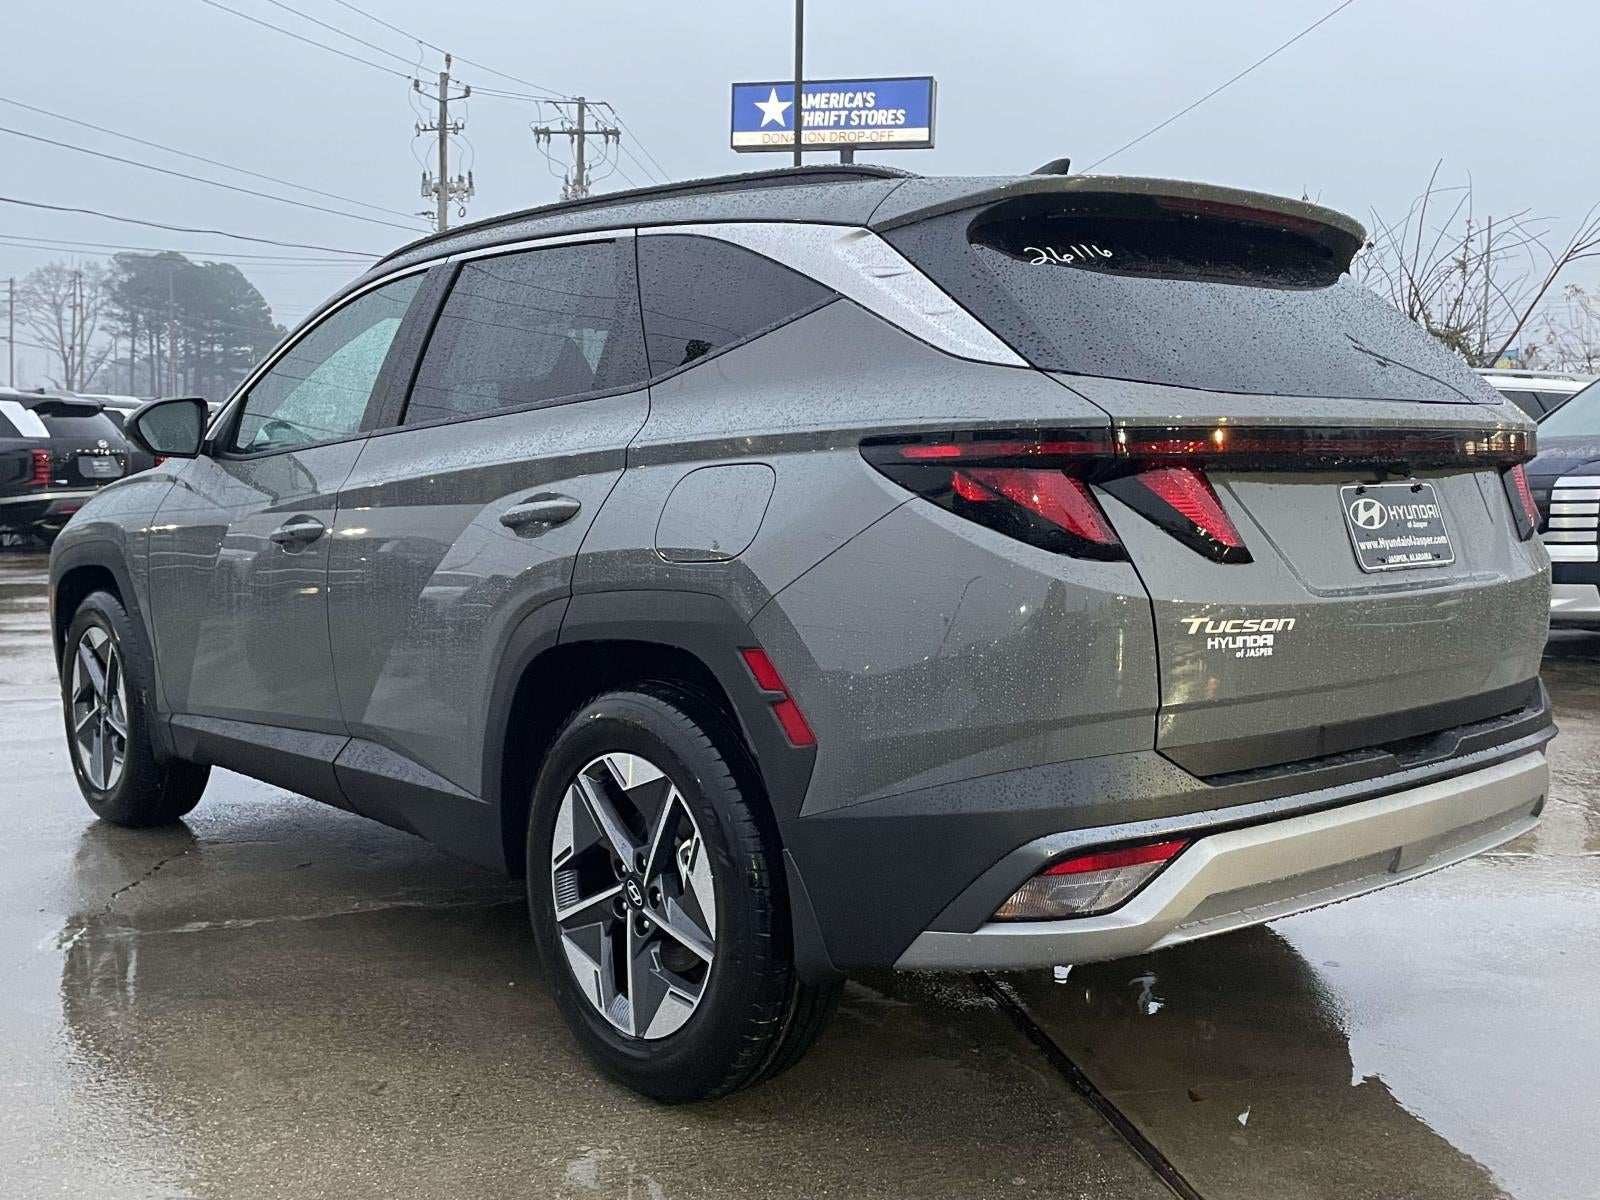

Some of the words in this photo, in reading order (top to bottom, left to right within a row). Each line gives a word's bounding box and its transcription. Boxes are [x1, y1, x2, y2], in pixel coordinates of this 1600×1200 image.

[801, 92, 875, 109] AMERICA'S
[801, 110, 848, 127] HRIFT
[850, 109, 906, 126] STORES
[762, 132, 826, 144] DONAION
[829, 130, 894, 142] DROP-OFF
[1387, 504, 1440, 520] HYUNDAI
[1207, 634, 1274, 649] HYUNDAI
[1235, 649, 1245, 658] of
[1245, 647, 1273, 658] JASPER
